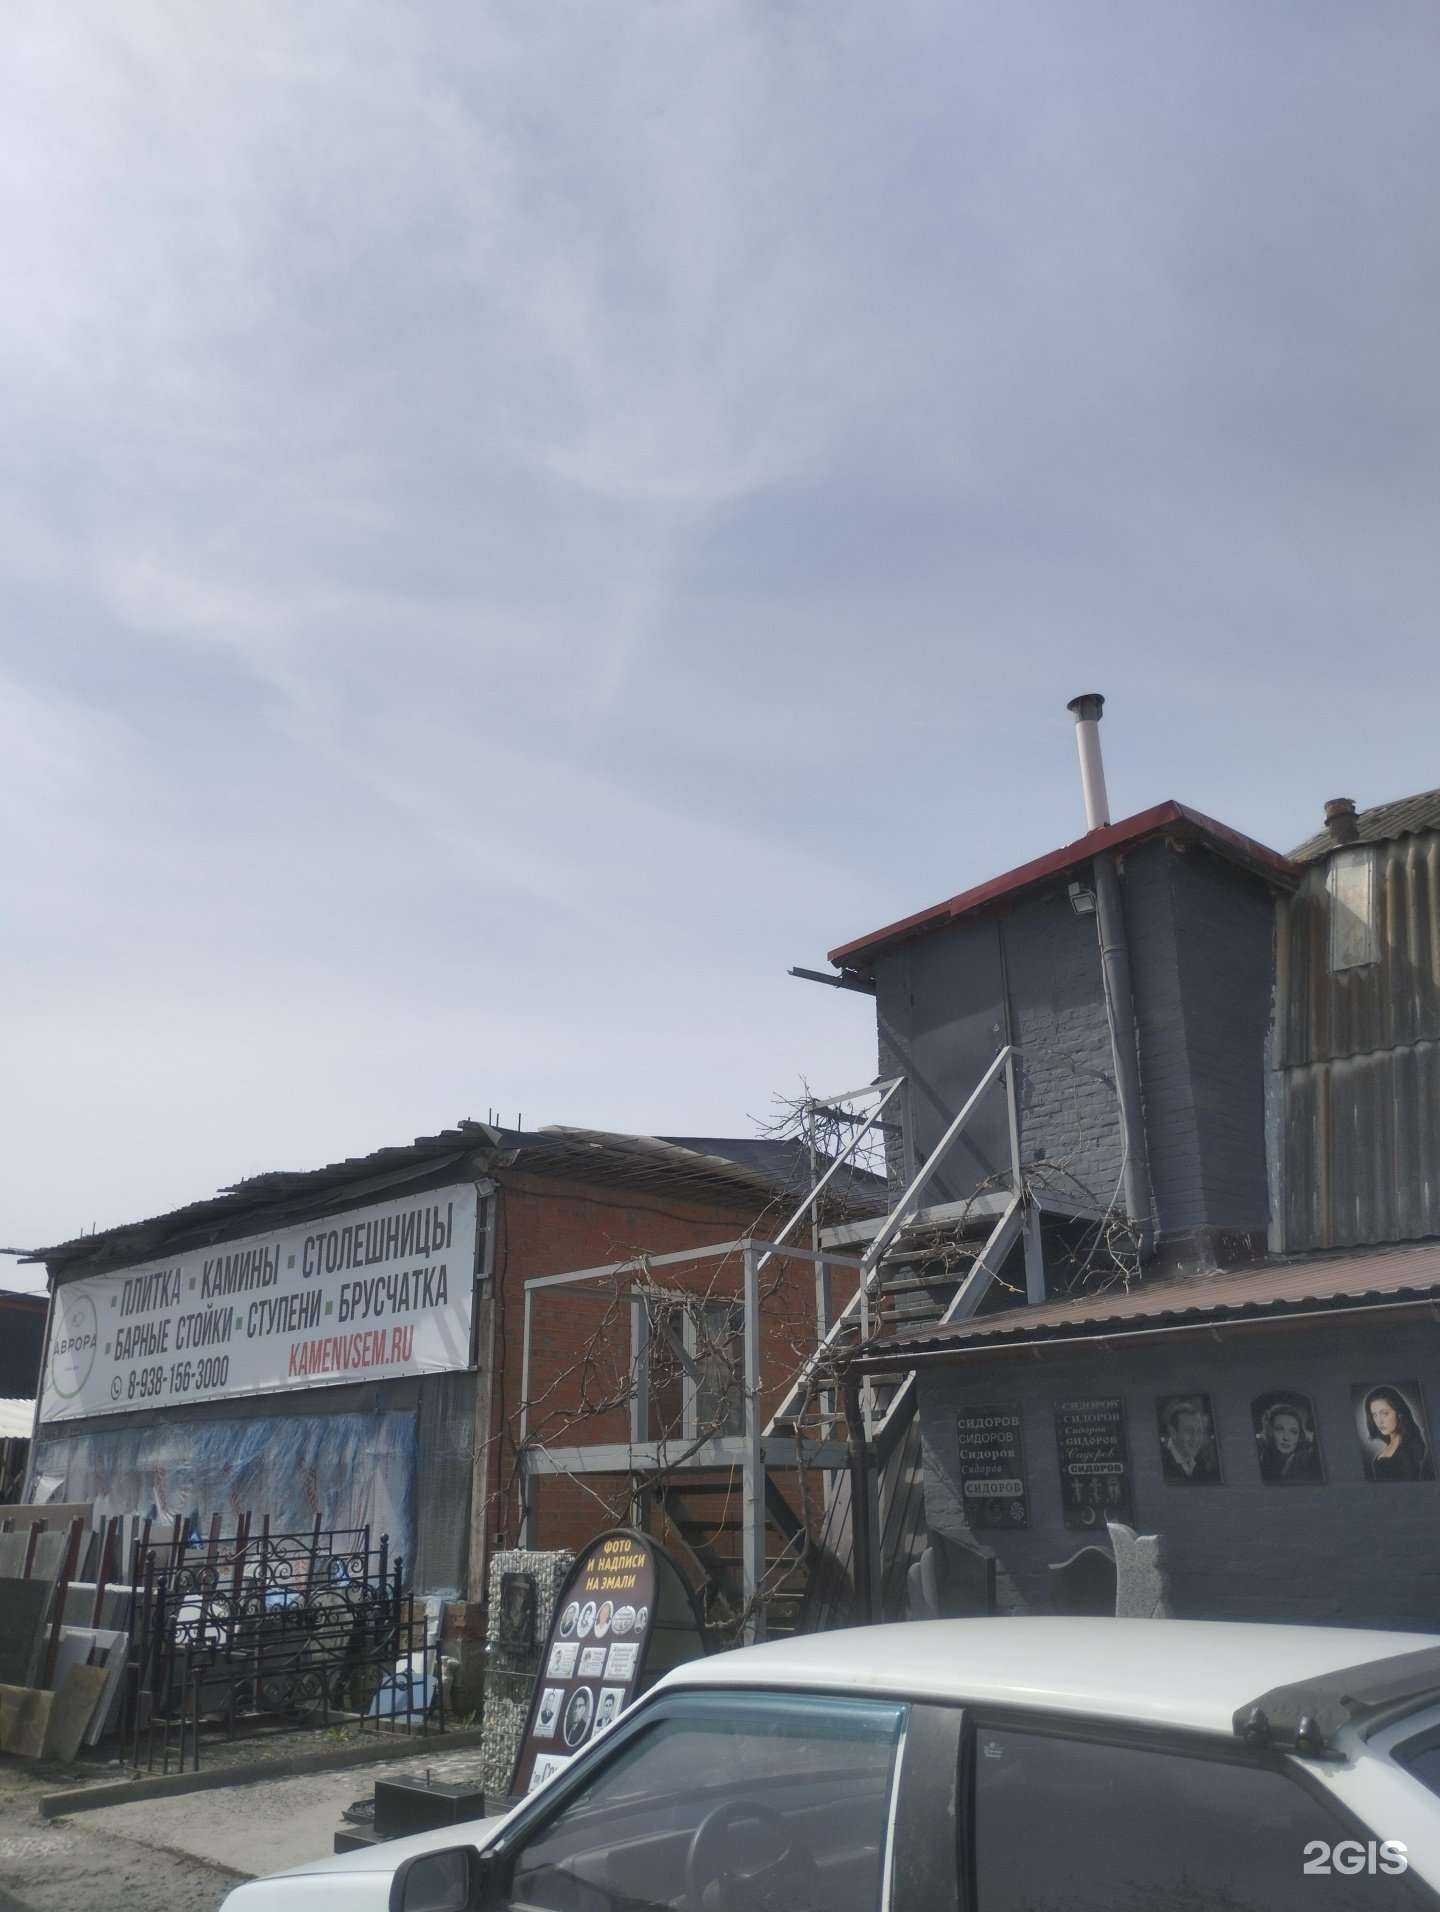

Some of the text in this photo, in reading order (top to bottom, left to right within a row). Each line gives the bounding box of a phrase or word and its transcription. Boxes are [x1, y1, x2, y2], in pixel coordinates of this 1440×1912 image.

[120, 1202, 454, 1317] ПЛИТКА КАМИНЫ СТОЛЕШНИЦЫ
[113, 1264, 448, 1361] БАРНЫЕ СТОЙКИ СТУПЕНИ БРУСЧАТКА
[53, 1333, 97, 1356] АВРОРА
[288, 1325, 415, 1377] KAMENVSEM.RU
[127, 1355, 229, 1399] 8-938-156-3000
[958, 1416, 1020, 1429] СИДОРОВ
[959, 1432, 1014, 1445] СИДОРОВ
[960, 1448, 1016, 1461] Сидоров
[966, 1482, 1021, 1494] СИДОРОВ
[604, 1539, 632, 1553] ФОТО
[587, 1554, 646, 1571] И НАДПИСИ
[586, 1575, 637, 1591] НА ЭМАЛИ
